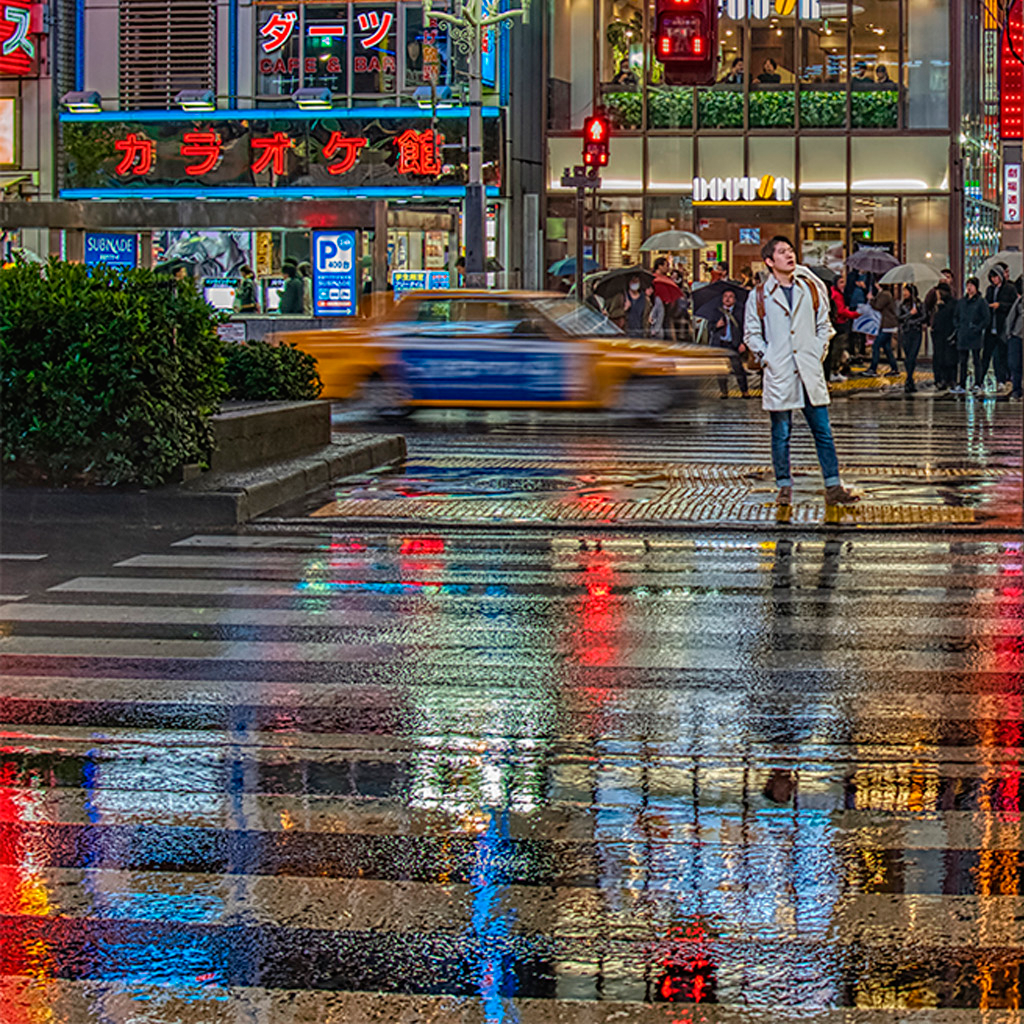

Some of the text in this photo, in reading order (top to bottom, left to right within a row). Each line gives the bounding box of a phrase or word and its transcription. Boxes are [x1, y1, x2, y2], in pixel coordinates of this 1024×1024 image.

[260, 11, 394, 53] ダーツ
[260, 56, 395, 74] CAFE & BAR
[115, 128, 443, 176] カラオケ館
[88, 237, 133, 254] SUBNADE
[320, 241, 337, 269] P
